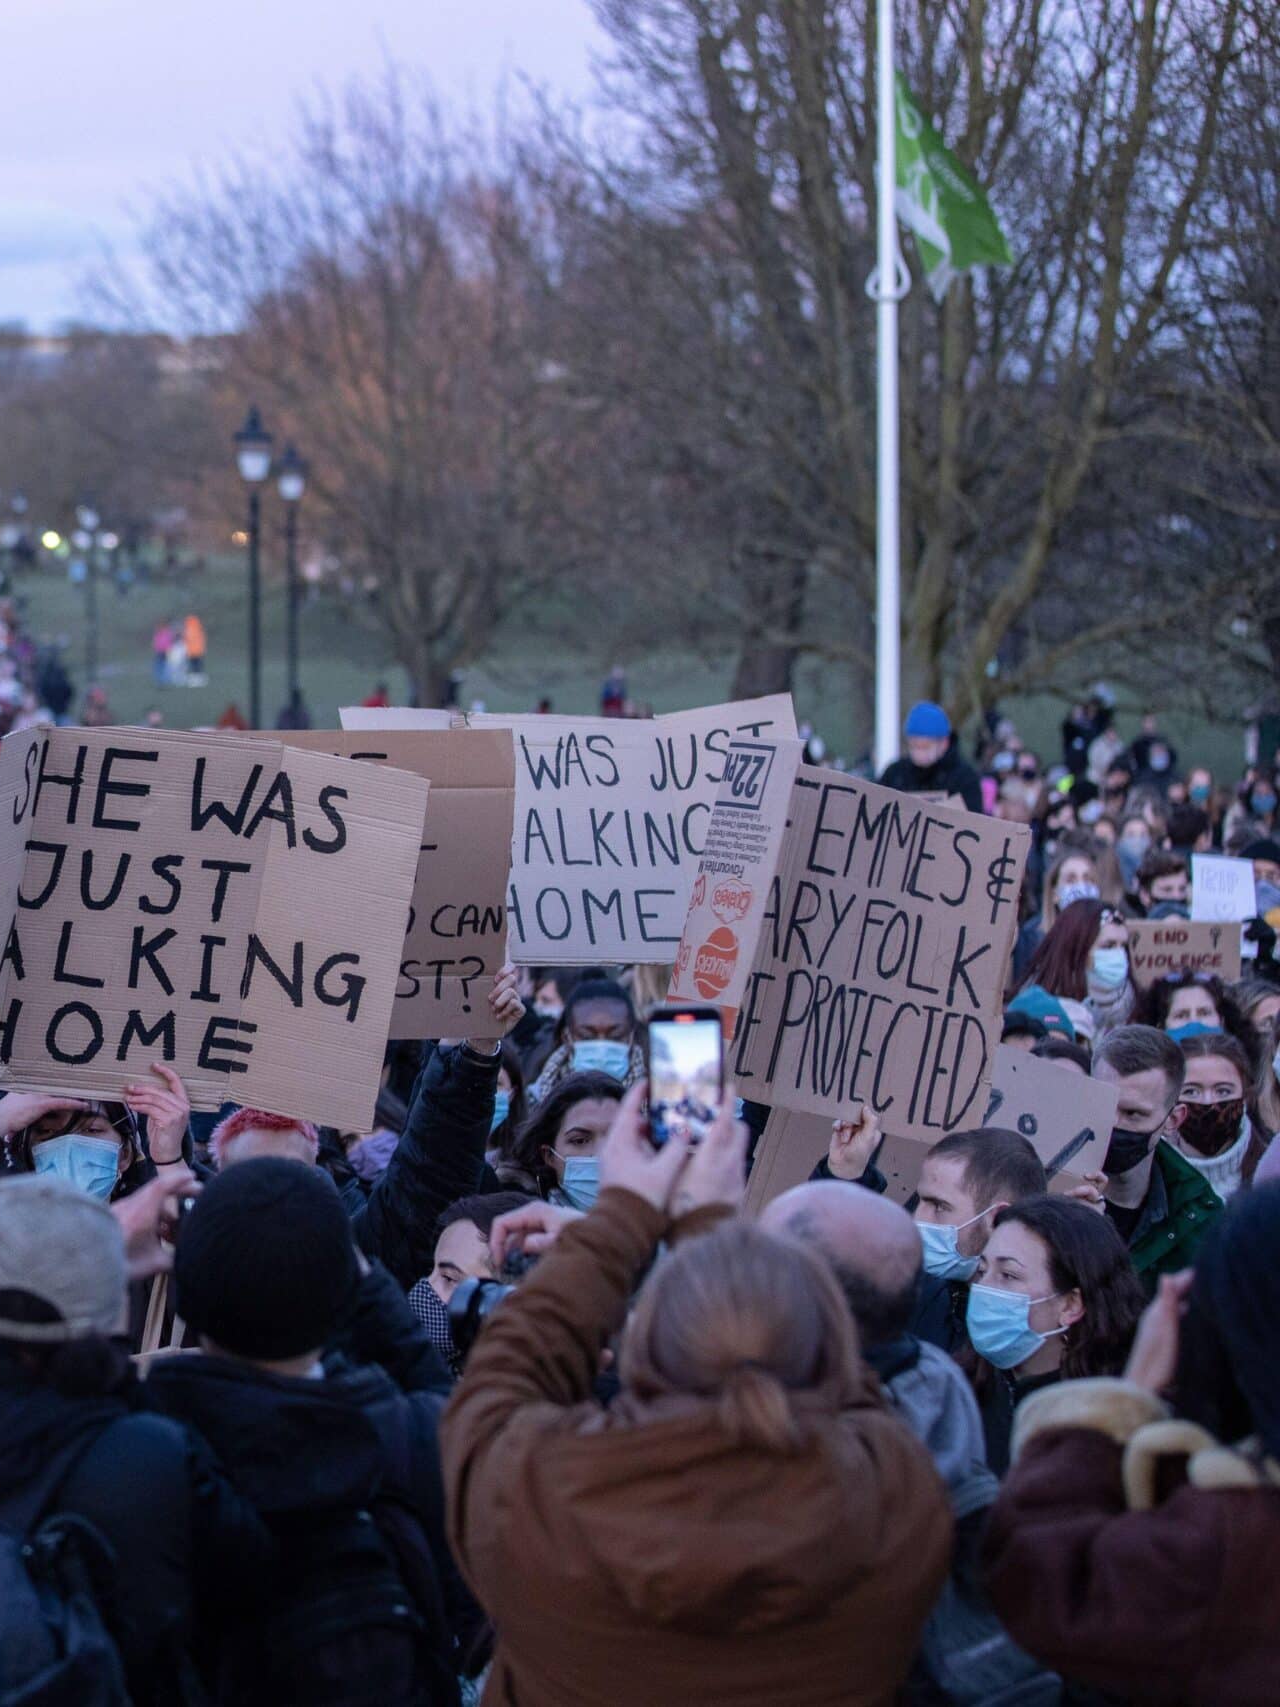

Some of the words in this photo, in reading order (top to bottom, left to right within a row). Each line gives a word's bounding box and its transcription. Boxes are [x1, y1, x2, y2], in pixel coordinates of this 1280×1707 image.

[13, 740, 159, 831] SHE
[191, 757, 349, 854] WAS
[520, 733, 620, 791] WAS
[17, 840, 251, 922] JUST
[430, 903, 503, 938] CAN
[852, 898, 991, 1009] FOLK
[1153, 930, 1188, 945] END
[1134, 952, 1223, 969] VIOLENCE
[766, 968, 988, 1132] PROTECTED
